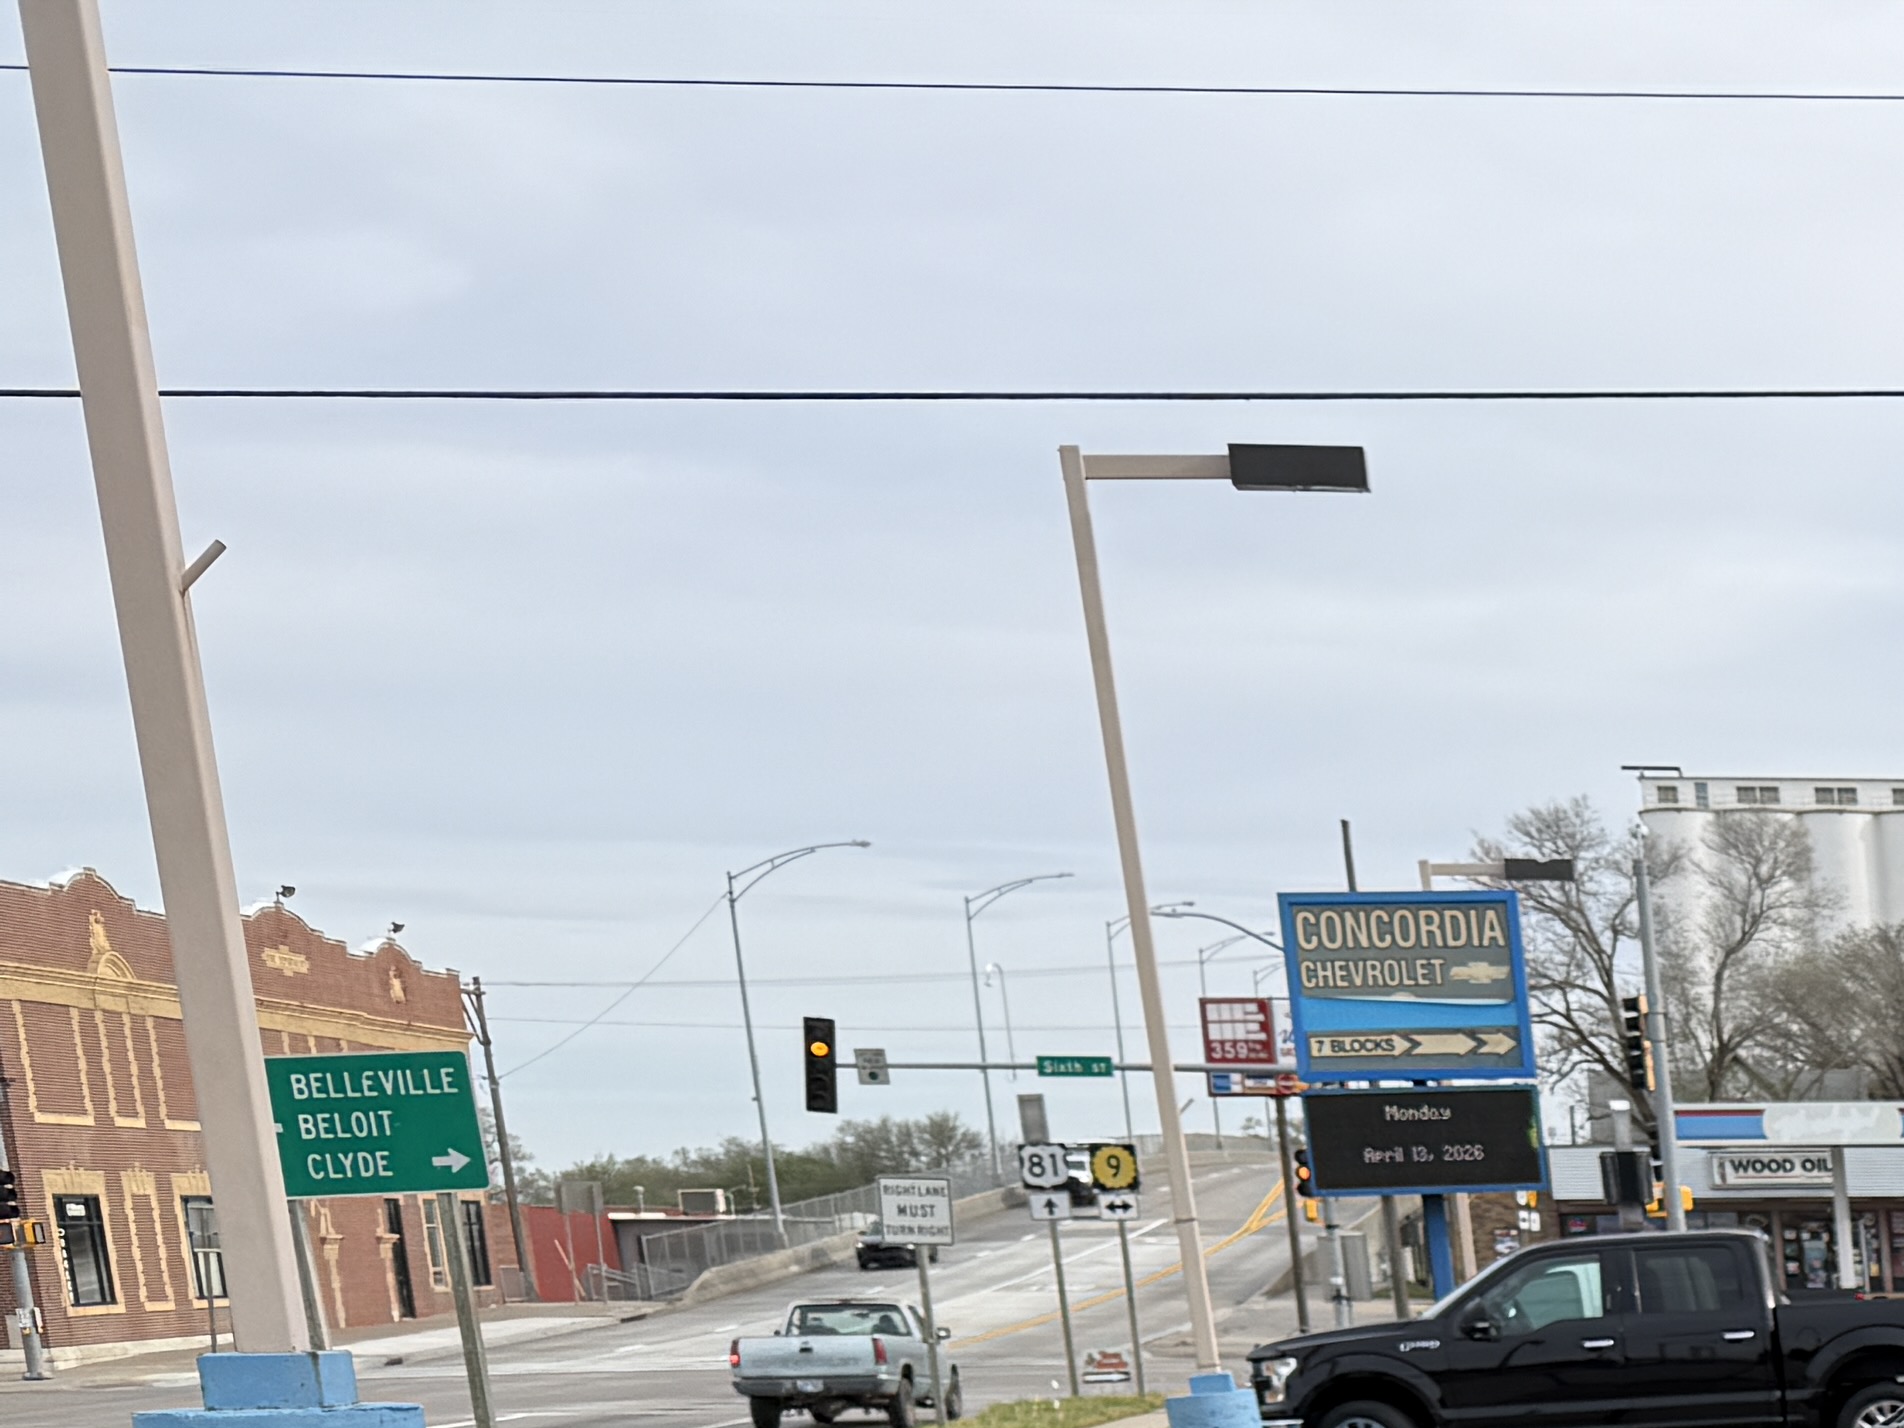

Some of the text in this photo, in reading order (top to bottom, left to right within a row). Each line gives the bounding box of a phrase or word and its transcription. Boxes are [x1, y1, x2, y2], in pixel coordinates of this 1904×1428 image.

[1296, 909, 1506, 950] CONCORDIA
[1301, 959, 1445, 988] CHEVROLET
[1314, 1038, 1396, 1053] 7 BLOCKS
[290, 1067, 459, 1100] BELLEVILLE
[1384, 1104, 1451, 1121] Monday
[298, 1110, 393, 1140] BELOIT
[307, 1151, 394, 1180] CLYDE
[1028, 1153, 1059, 1178] 81
[1363, 1147, 1405, 1163] April
[1443, 1144, 1485, 1161] 2026
[1105, 1154, 1121, 1178] 9
[1729, 1158, 1833, 1174] WOOD OIL
[918, 1186, 948, 1197] LANE
[896, 1204, 936, 1218] MUST
